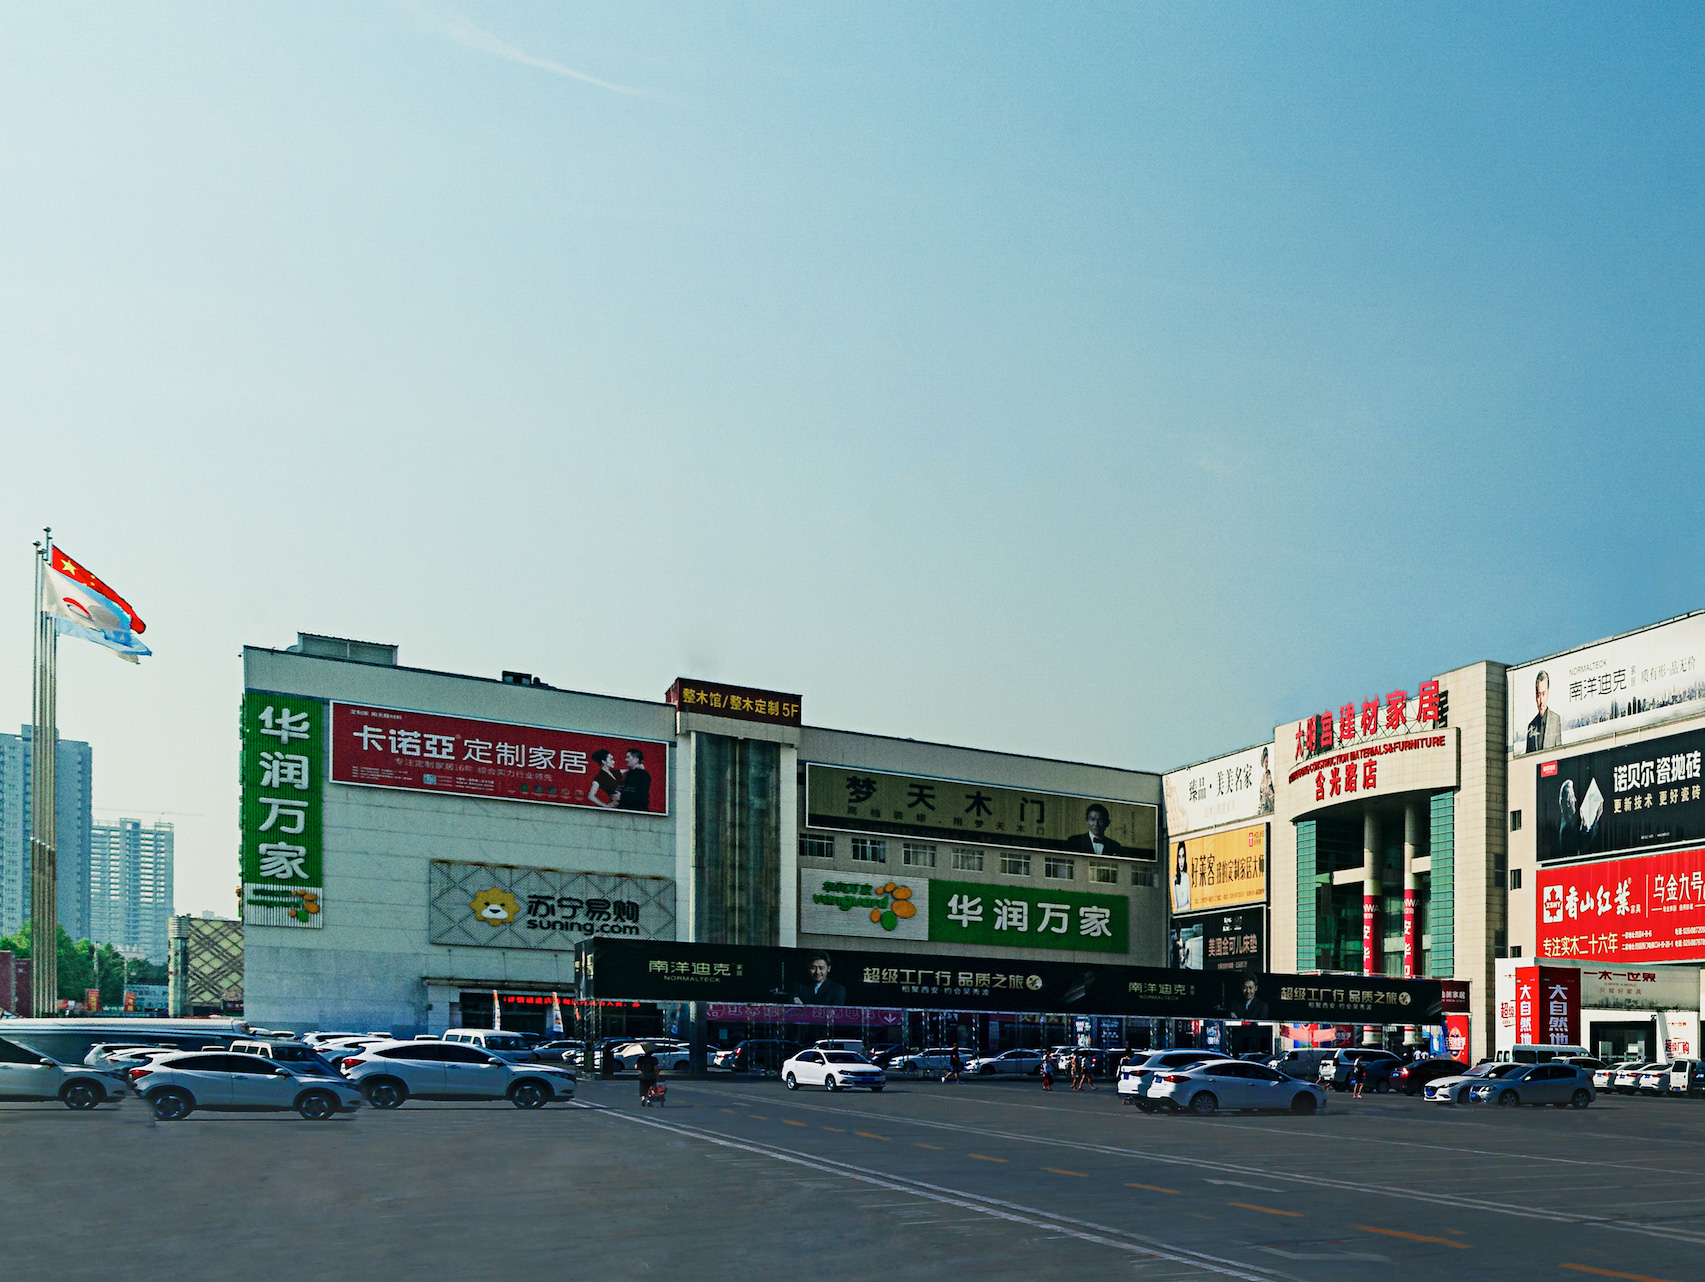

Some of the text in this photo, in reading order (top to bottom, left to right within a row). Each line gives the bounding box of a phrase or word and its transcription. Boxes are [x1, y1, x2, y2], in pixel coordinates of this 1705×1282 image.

[1569, 669, 1627, 702] 南洋迪克
[782, 702, 800, 718] 5F
[1295, 680, 1440, 761] 大明宫建材家居
[462, 738, 589, 774] 定制家居
[1315, 758, 1378, 801] 含光路店
[1614, 750, 1701, 793] 诺贝尔 瓷抛砖
[258, 705, 311, 880] 华润万家
[846, 775, 1046, 825] 梦天木门
[1613, 784, 1702, 814] 更新技术 更好瓷砖
[1653, 871, 1704, 904] 乌金九号
[527, 894, 640, 924] 苏宁易购
[947, 894, 1112, 938] 华润万家
[526, 919, 640, 936] suning.com
[1543, 932, 1618, 957] 专注实木二十六年
[648, 960, 731, 976] 南洋迪克
[663, 974, 721, 983] NORMALTECK
[863, 967, 1024, 990] 超级工厂行 品质之旅
[1583, 971, 1656, 983] 一木一世界
[1128, 982, 1187, 995] 南洋迪克
[1281, 986, 1397, 1005] 超级工厂行 品质之旅
